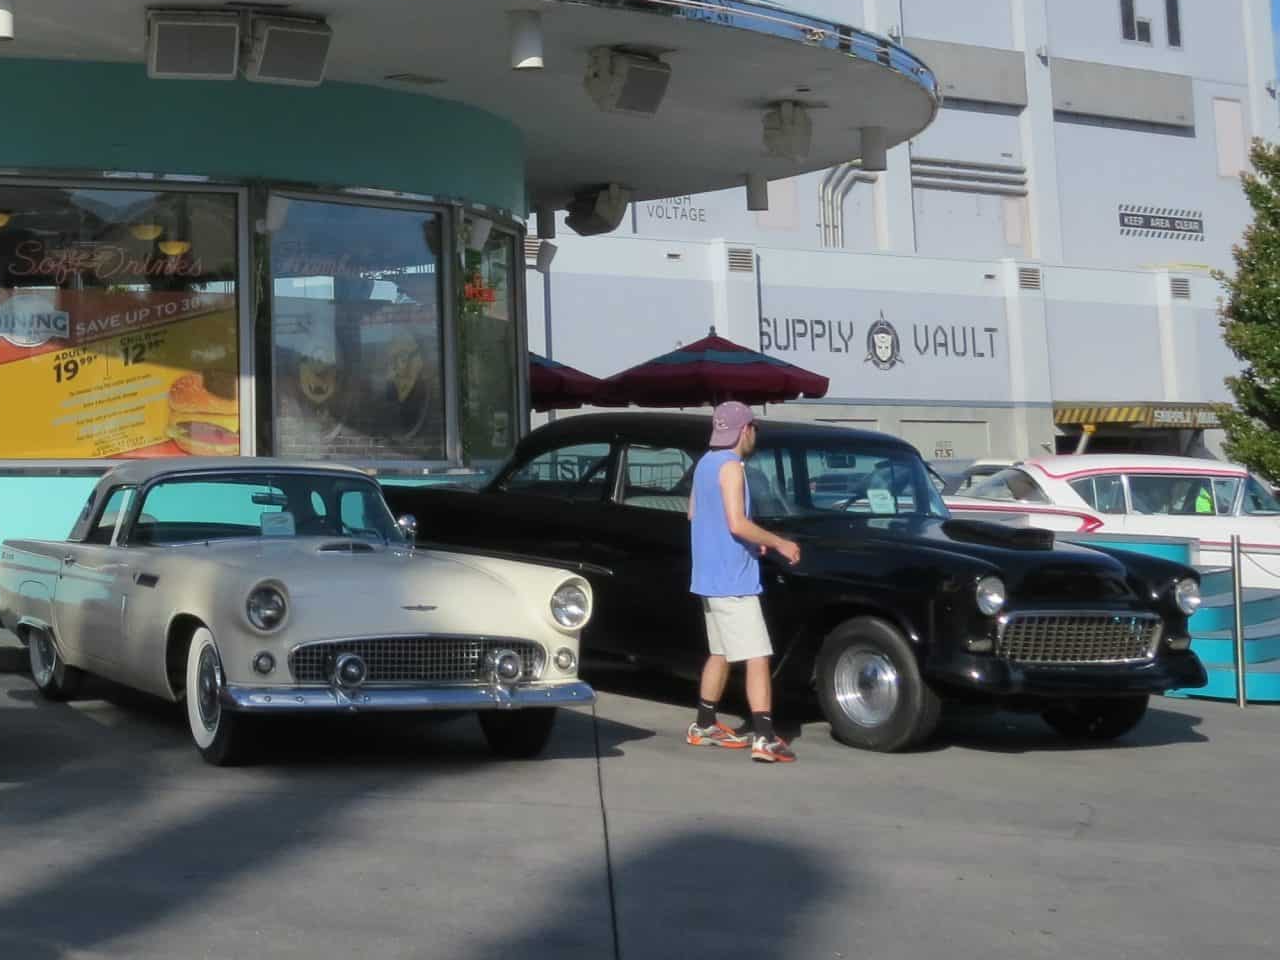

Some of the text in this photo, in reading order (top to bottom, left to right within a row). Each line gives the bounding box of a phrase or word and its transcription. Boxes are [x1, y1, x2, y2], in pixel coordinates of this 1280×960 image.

[647, 204, 706, 223] VOLTAGE
[75, 316, 121, 337] SAVE
[125, 308, 151, 324] UP
[156, 301, 177, 317] TO
[760, 317, 999, 358] SUPPLY VAULT
[53, 346, 88, 363] ADULT
